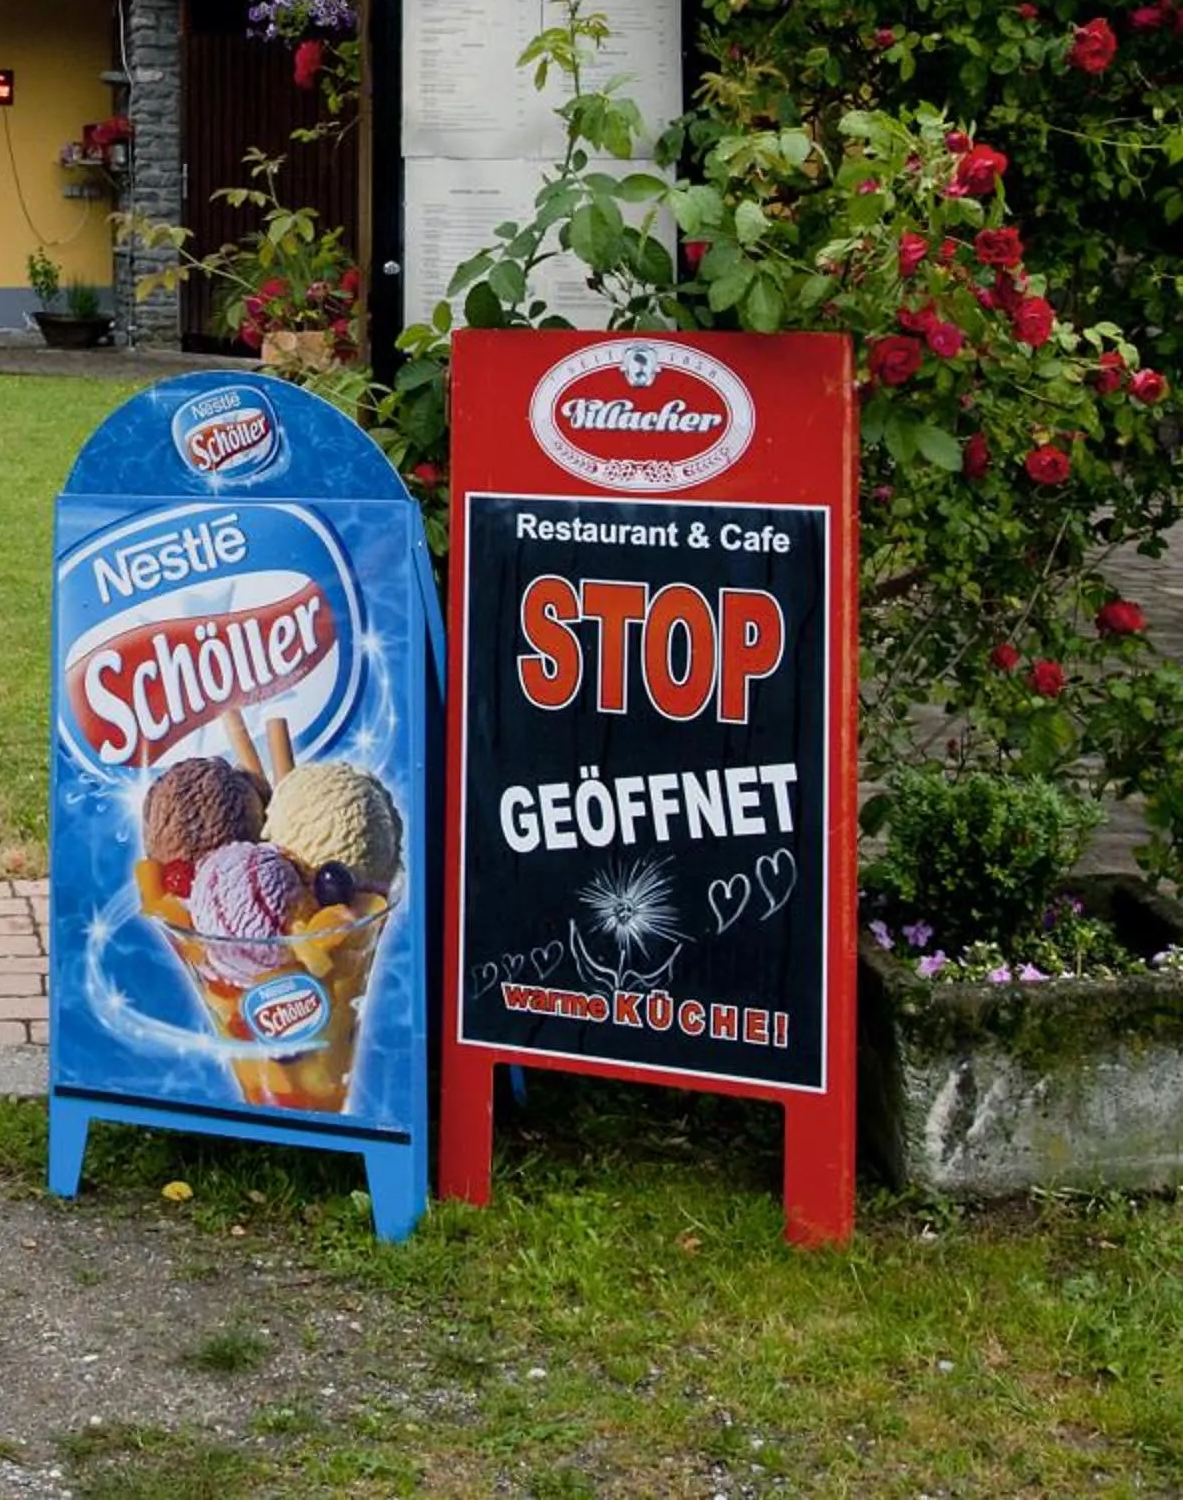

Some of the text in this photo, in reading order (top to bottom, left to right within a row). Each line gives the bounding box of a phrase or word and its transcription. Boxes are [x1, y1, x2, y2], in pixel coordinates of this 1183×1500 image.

[190, 414, 266, 471] Schöller
[561, 398, 722, 434] Villacher
[92, 513, 247, 604] Nestlé
[517, 513, 791, 553] Restaurant & Cafe
[84, 596, 320, 765] Schöller
[517, 573, 785, 725] STOP
[500, 763, 798, 853] GEÖFFNET
[501, 981, 608, 1023] warme
